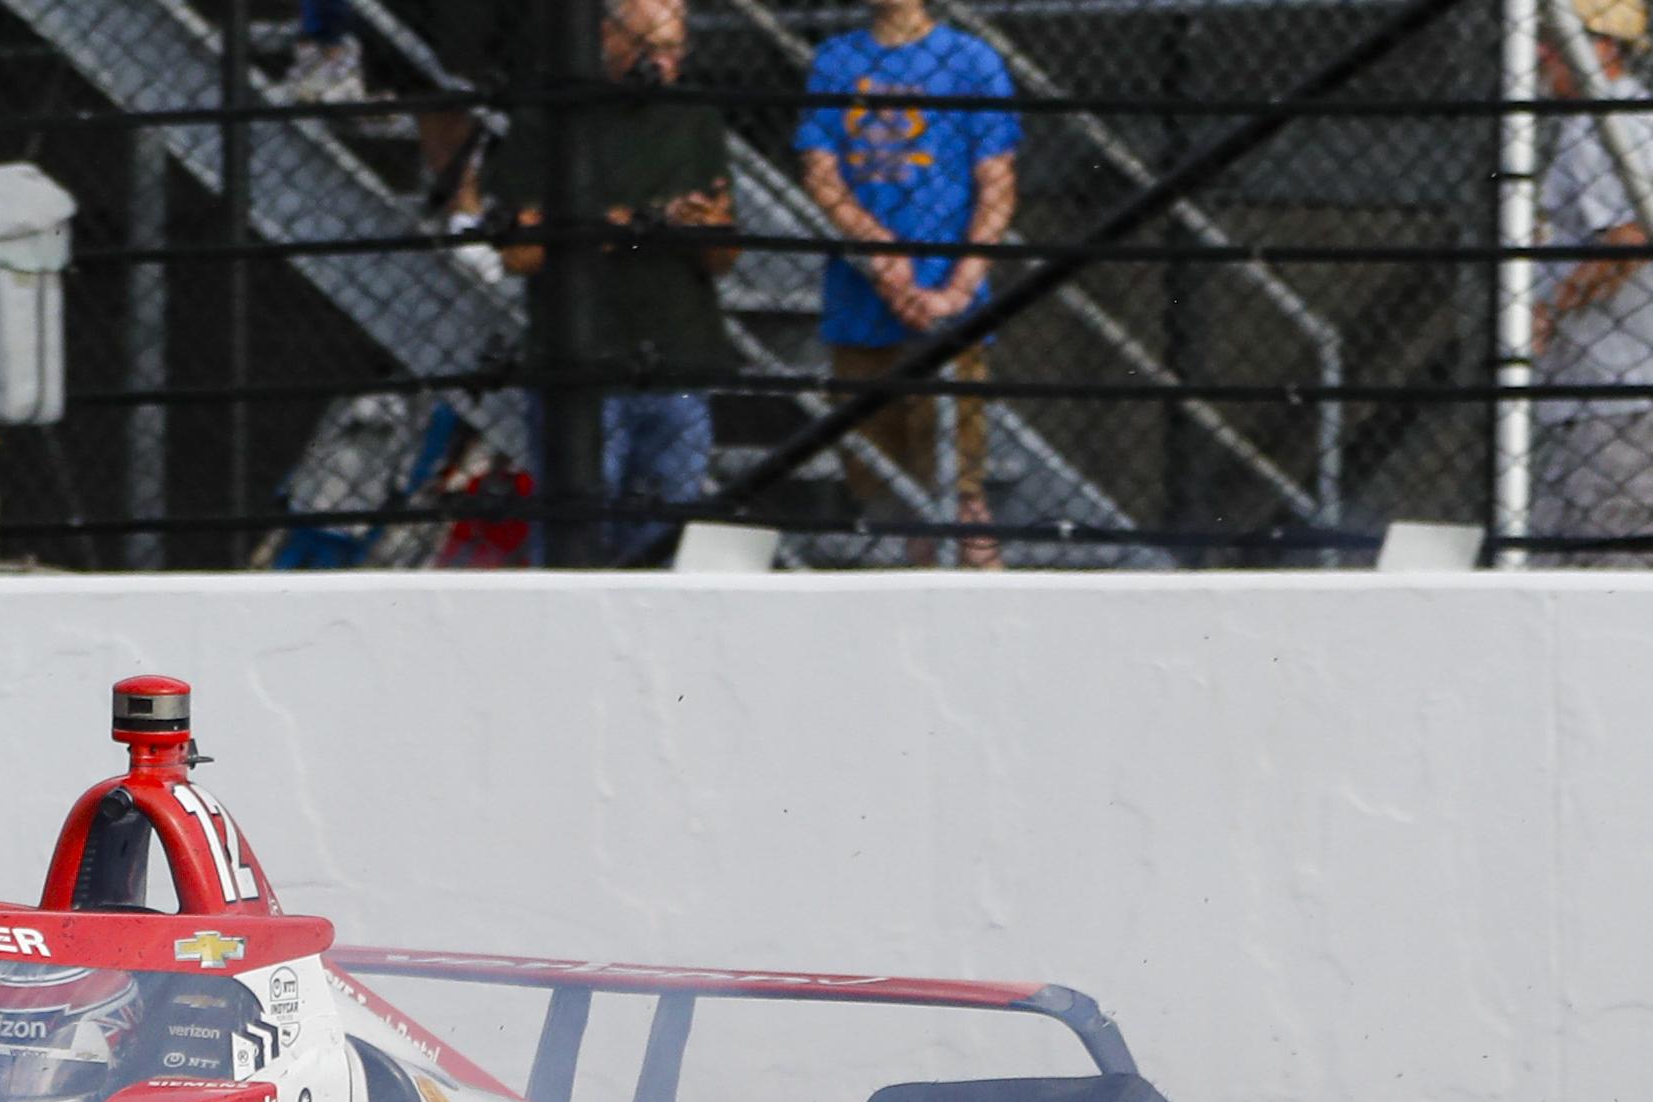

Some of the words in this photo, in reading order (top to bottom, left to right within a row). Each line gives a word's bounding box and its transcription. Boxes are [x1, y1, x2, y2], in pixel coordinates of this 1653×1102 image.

[172, 783, 259, 903] 12
[168, 1023, 221, 1040] verizon
[187, 1057, 220, 1069] NTT
